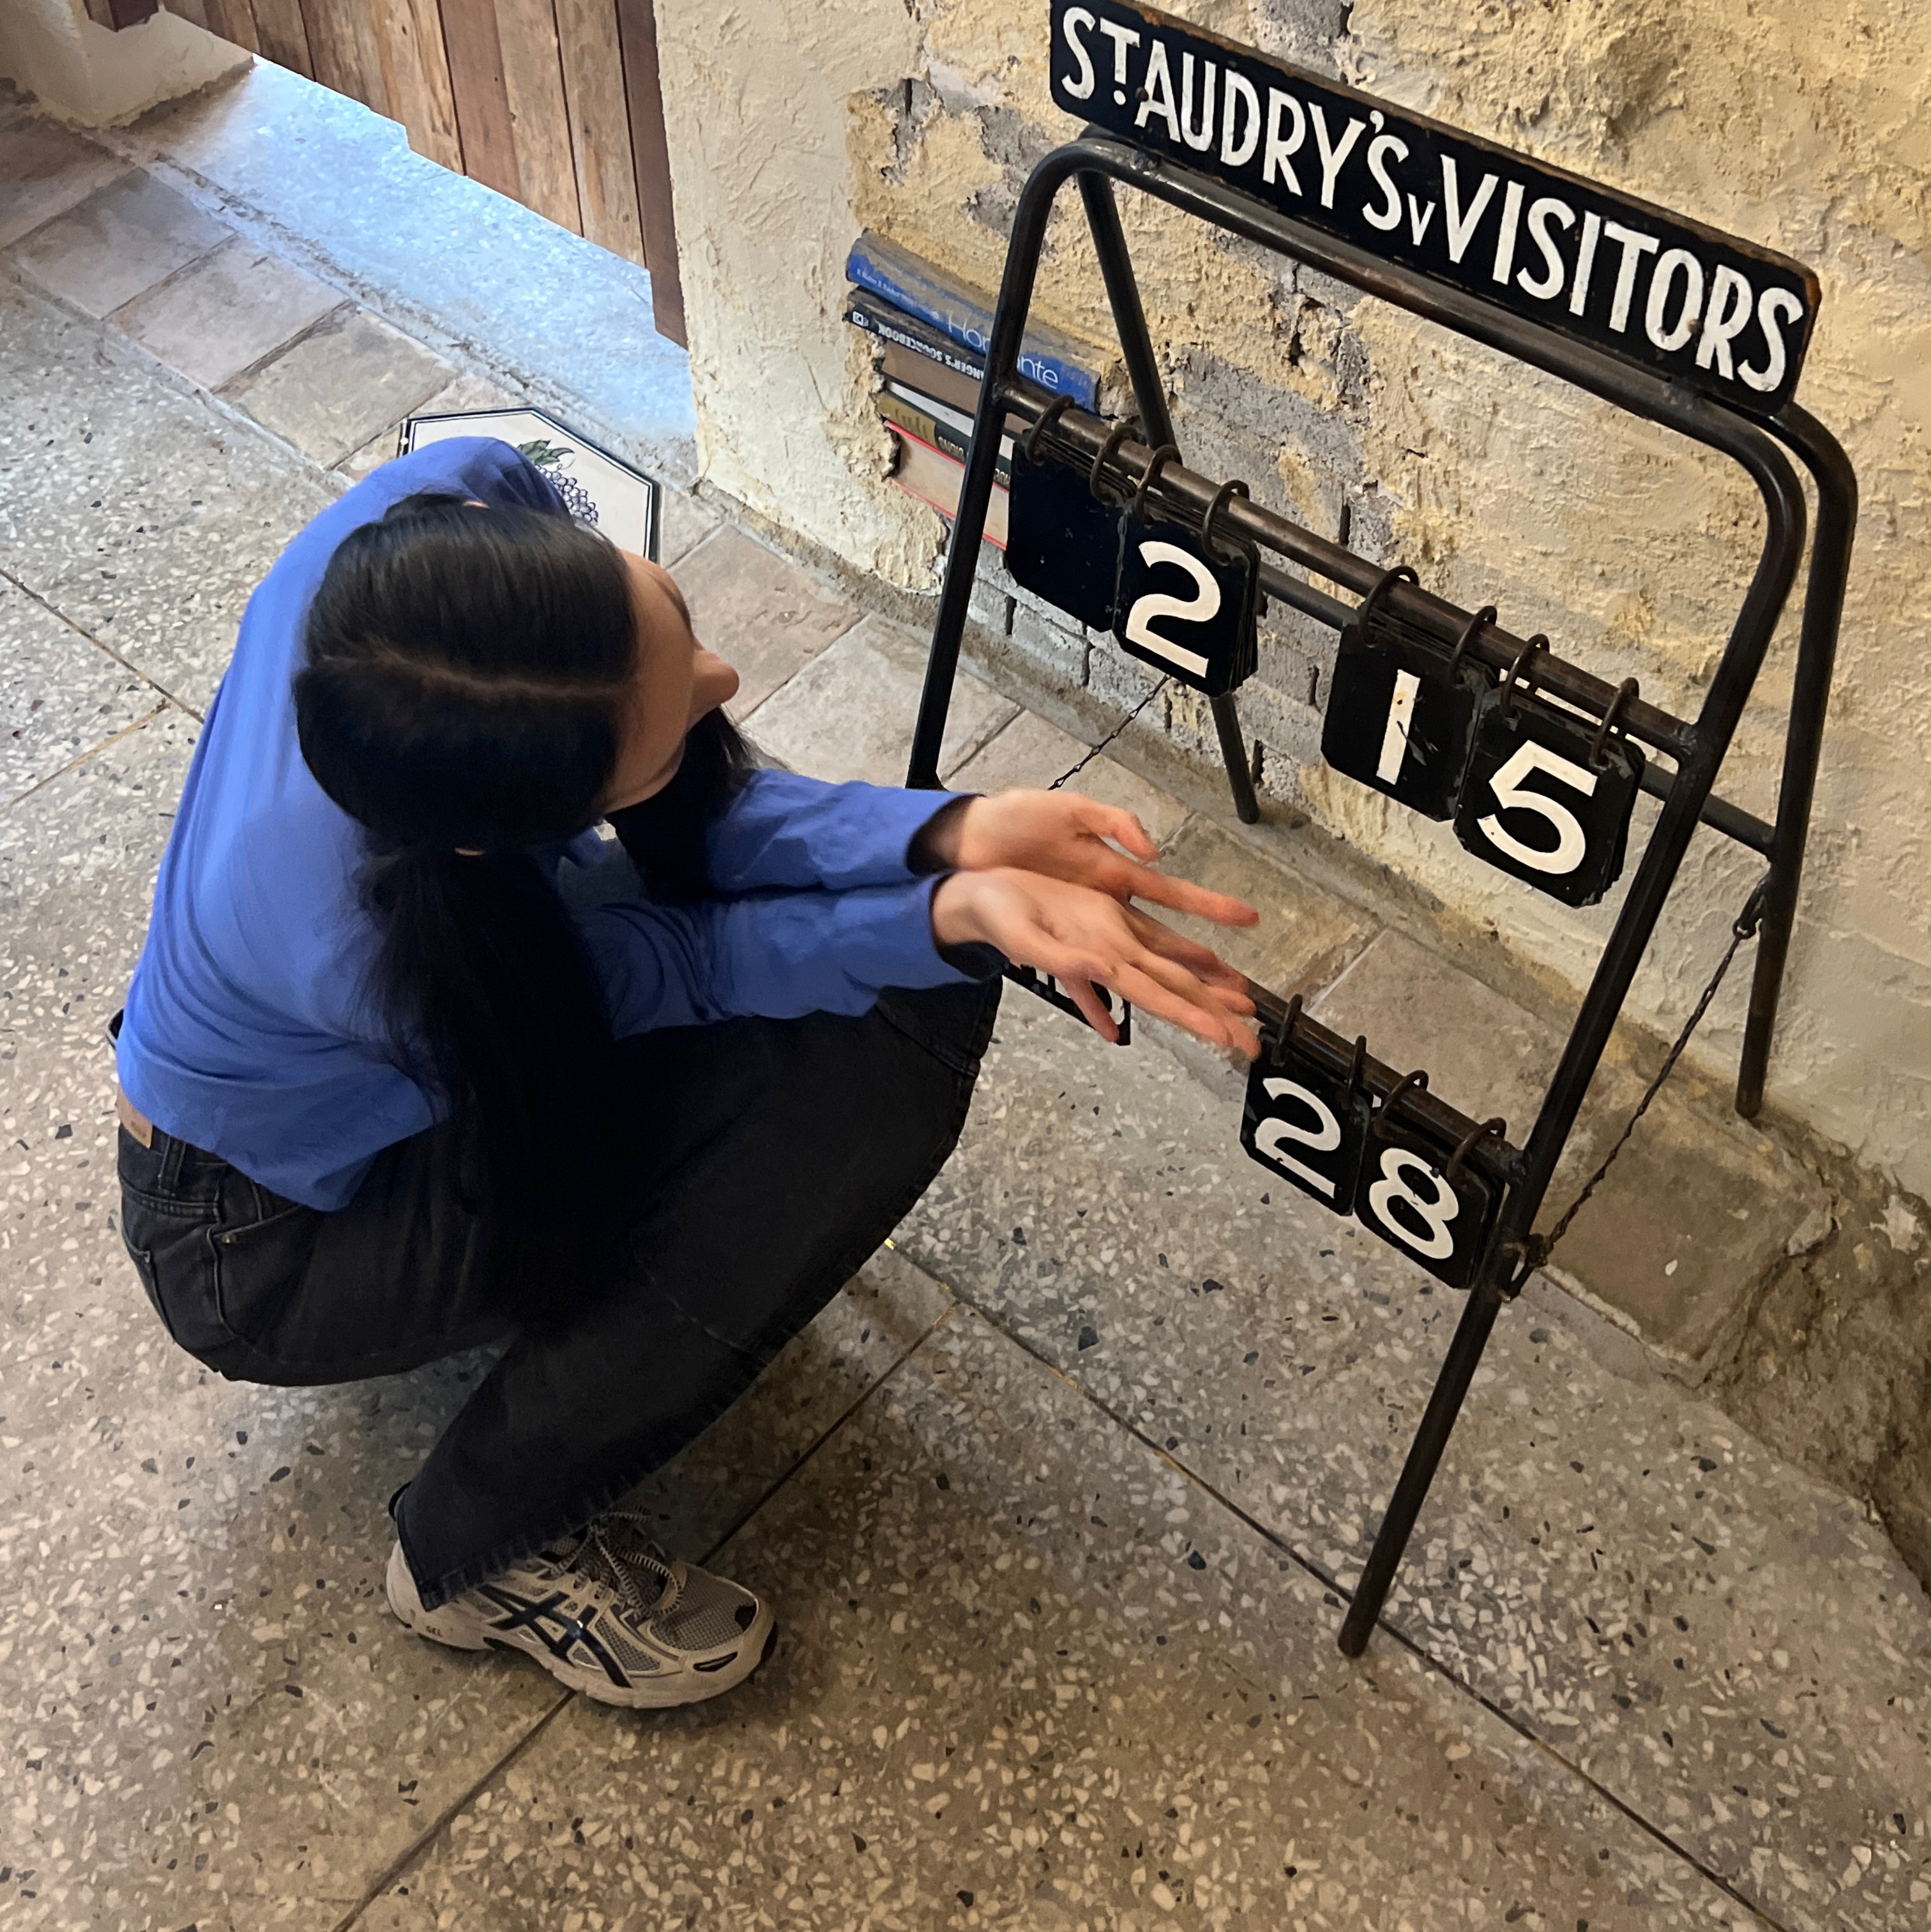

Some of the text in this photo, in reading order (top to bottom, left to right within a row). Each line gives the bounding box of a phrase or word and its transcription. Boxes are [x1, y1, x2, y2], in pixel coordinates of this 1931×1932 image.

[1134, 40, 1409, 231] AUDRY'S
[1441, 153, 1804, 392] VISITORS
[1126, 541, 1221, 678] 2
